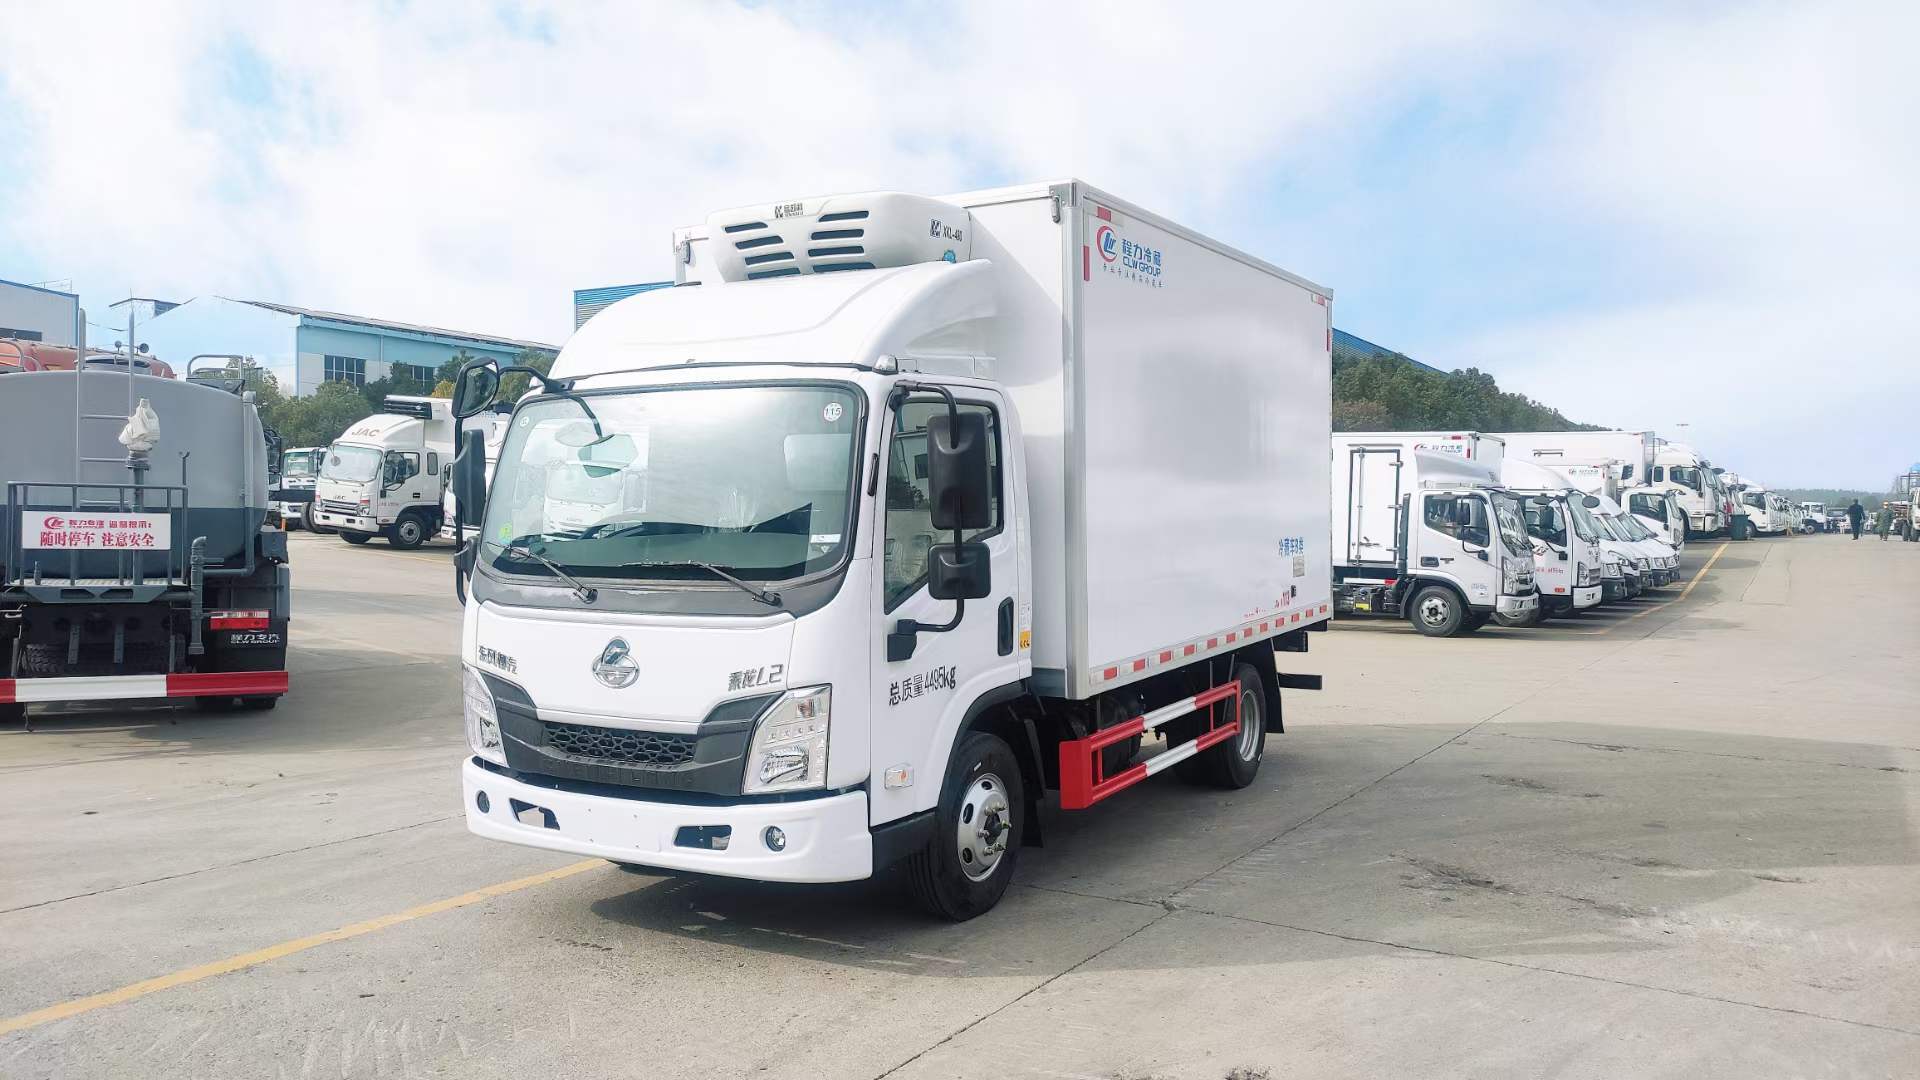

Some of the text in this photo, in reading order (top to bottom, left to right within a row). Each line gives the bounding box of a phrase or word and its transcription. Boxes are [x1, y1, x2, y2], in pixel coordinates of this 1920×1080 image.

[1121, 238, 1162, 267] 程力冷藏
[1122, 255, 1162, 278] CLW GROUP
[351, 427, 379, 437] JAC
[40, 531, 155, 547] 随时停车 注意安全
[888, 665, 957, 706] 总质量4495kg
